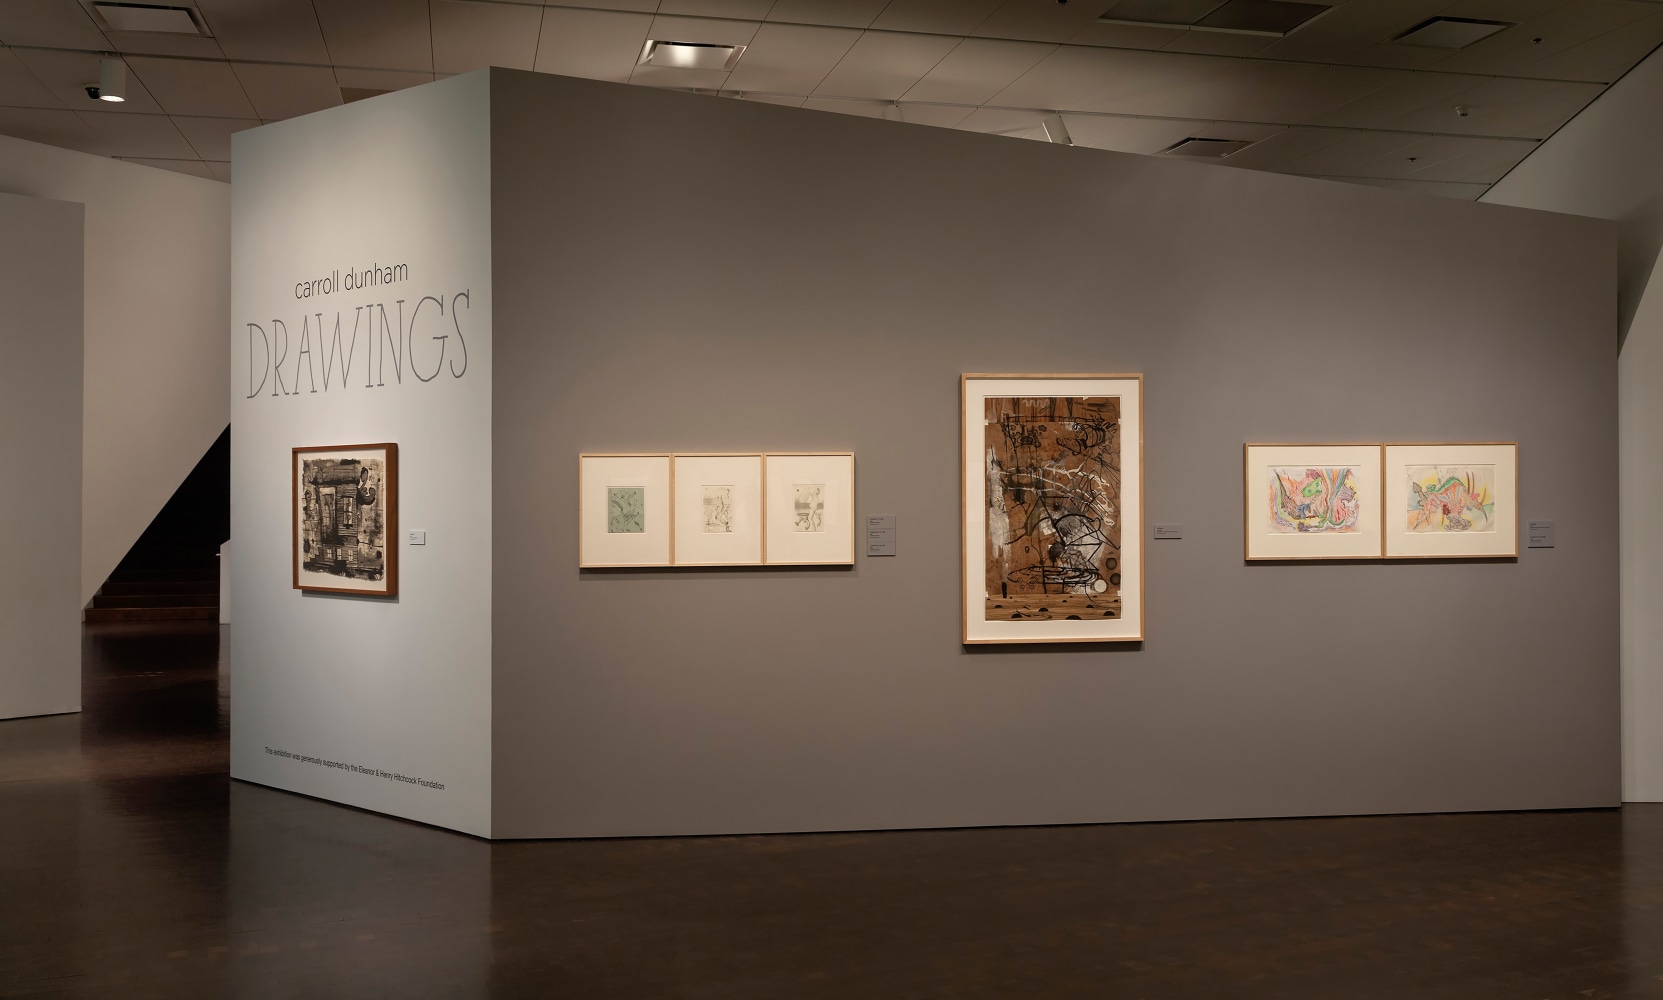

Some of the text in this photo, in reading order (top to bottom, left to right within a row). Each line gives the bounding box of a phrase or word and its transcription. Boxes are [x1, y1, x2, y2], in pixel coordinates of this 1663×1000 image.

[295, 262, 408, 299] carroll dunham
[246, 288, 470, 399] DRAWINGS
[265, 746, 273, 755] This
[273, 749, 292, 758] exhibition
[301, 755, 322, 766] generously
[323, 759, 344, 770] supported
[344, 763, 350, 772] by
[350, 764, 358, 772] the
[358, 765, 375, 776] Eleanor
[375, 768, 380, 777] &
[380, 770, 394, 781] Henry
[394, 773, 418, 785] Hitchcock
[417, 777, 445, 790] Foundation
